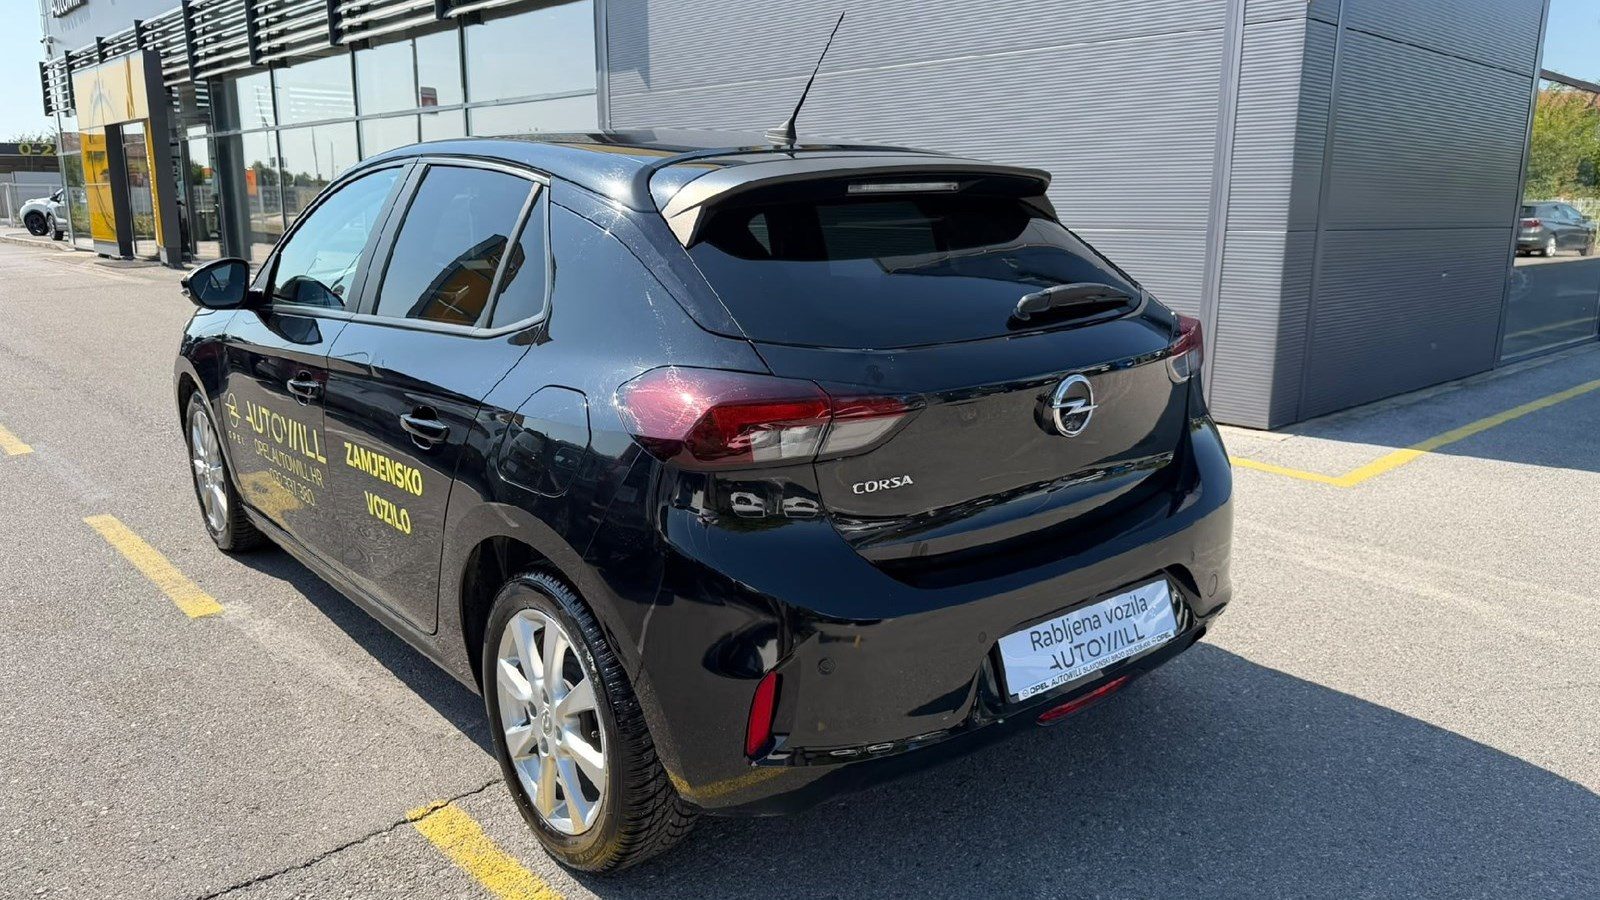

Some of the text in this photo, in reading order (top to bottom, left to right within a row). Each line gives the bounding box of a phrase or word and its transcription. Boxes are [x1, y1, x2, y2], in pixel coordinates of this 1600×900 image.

[18, 143, 57, 156] 0-2
[246, 400, 327, 464] AUTOWILL
[344, 441, 423, 497] ZAMJENSKO
[852, 474, 914, 495] CORSA
[364, 490, 412, 535] VOZILO
[1029, 595, 1148, 652] Rabljena vozila
[1049, 622, 1146, 670] AUTOWILL
[1030, 681, 1050, 695] OPEL
[1156, 631, 1172, 643] OPEL
